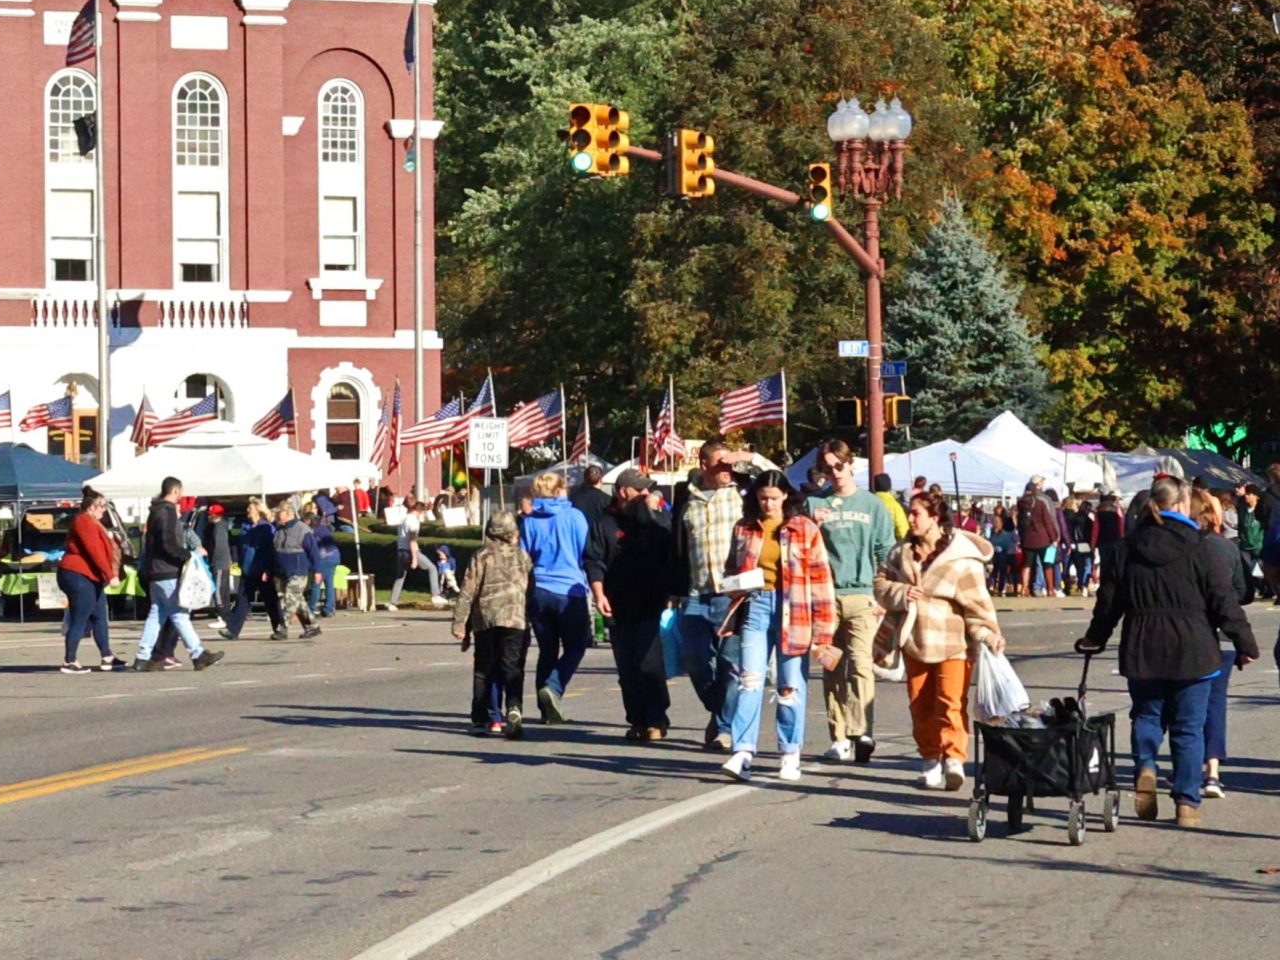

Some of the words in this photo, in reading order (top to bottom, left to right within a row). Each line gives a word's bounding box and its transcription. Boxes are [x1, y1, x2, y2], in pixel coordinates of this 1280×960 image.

[474, 422, 505, 431] WEIGHT
[477, 432, 499, 440] LIMIT
[482, 442, 495, 452] 10
[474, 453, 502, 464] TONS
[842, 510, 870, 524] BEACH
